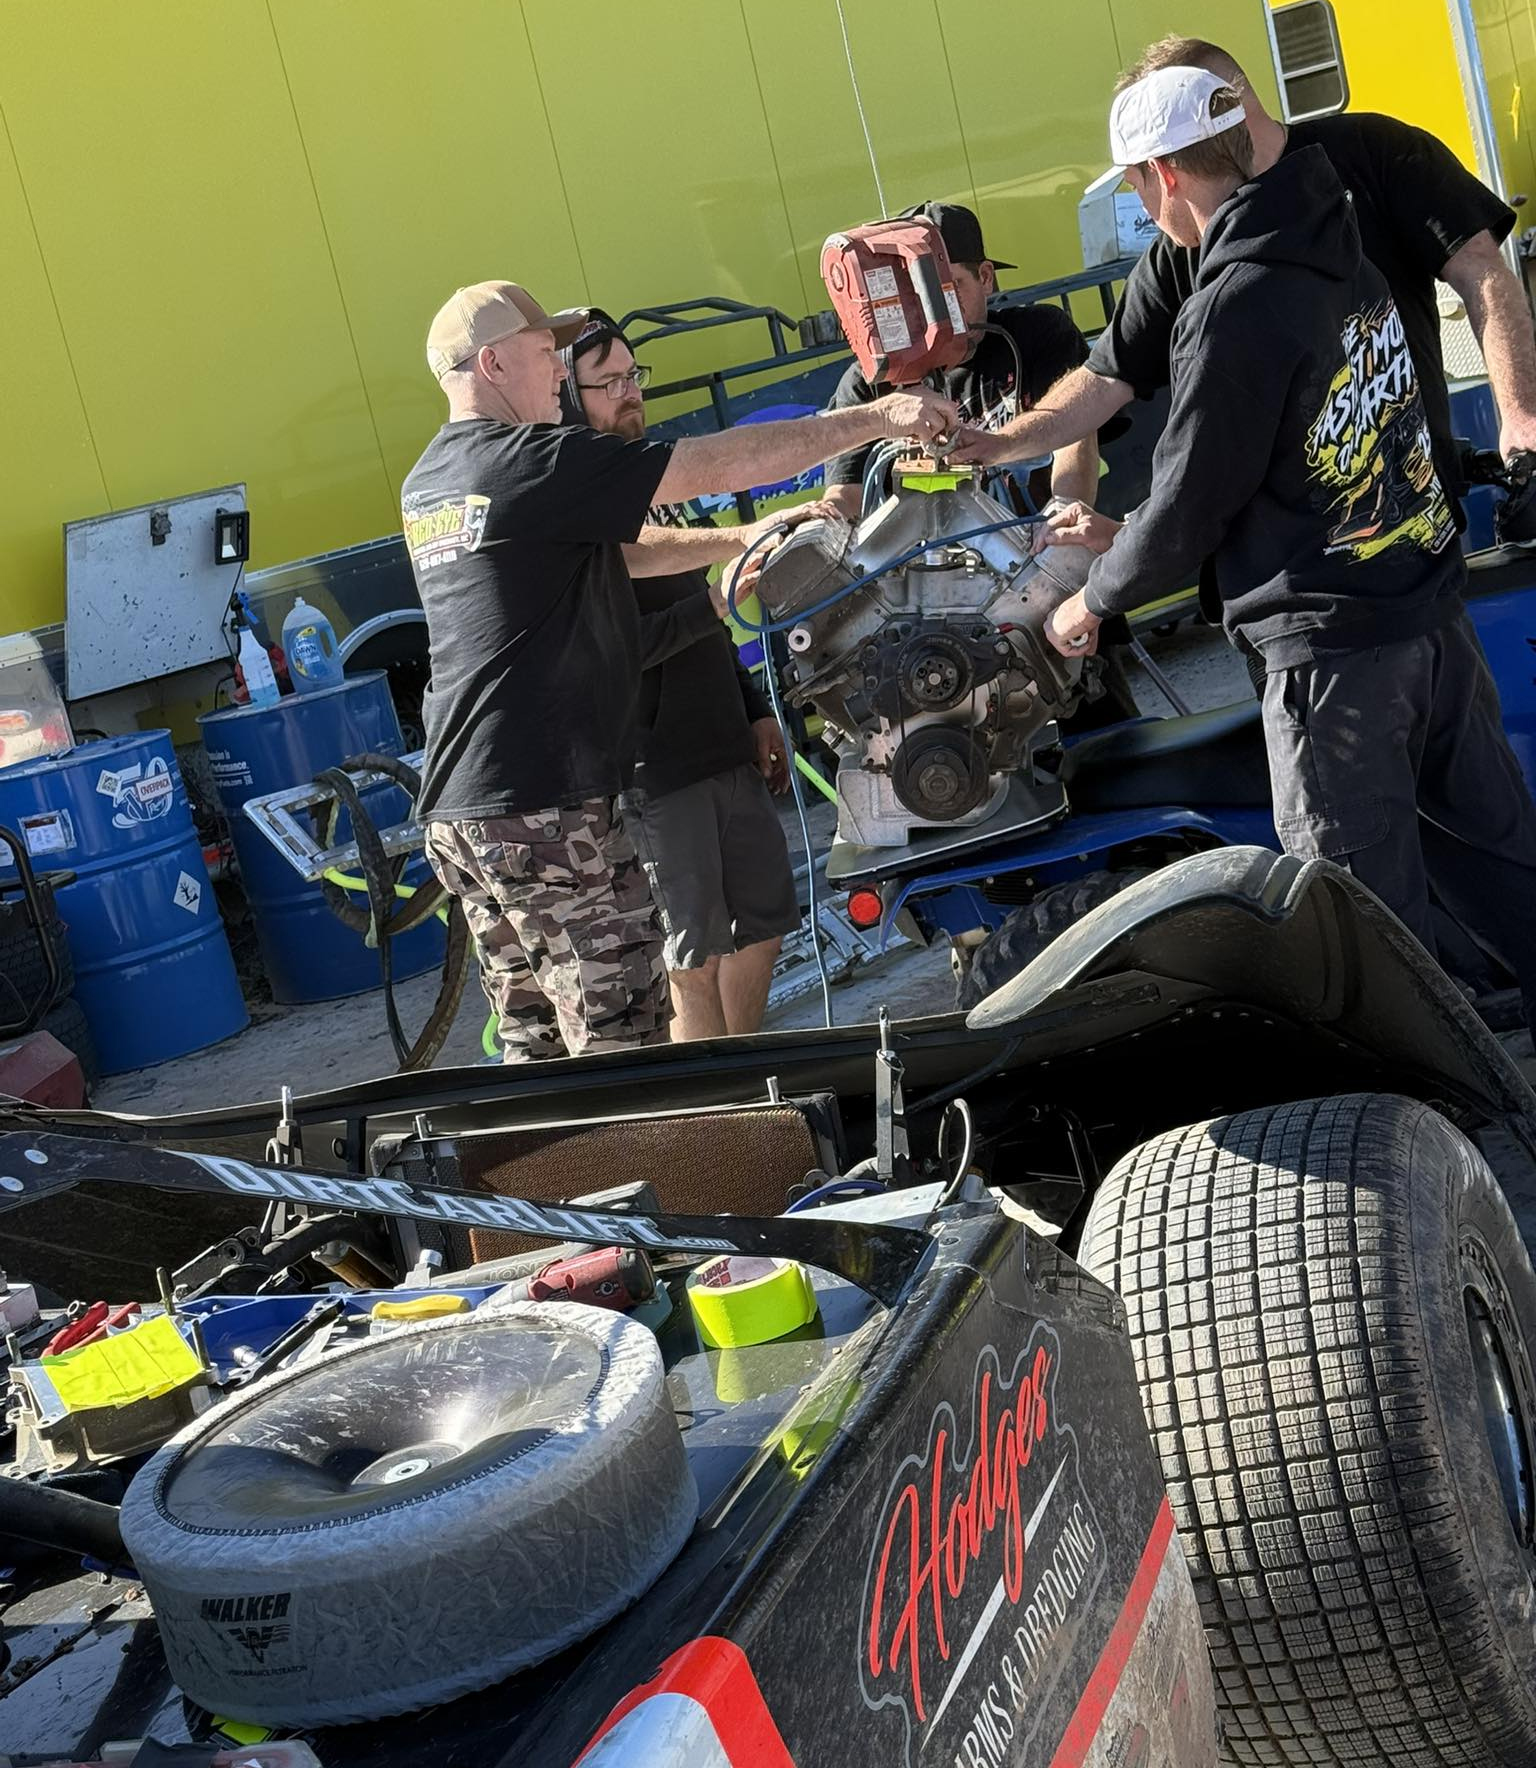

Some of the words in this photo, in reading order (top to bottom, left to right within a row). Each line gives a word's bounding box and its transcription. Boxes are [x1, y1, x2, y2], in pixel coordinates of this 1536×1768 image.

[140, 778, 171, 796] OVERPACK
[869, 1345, 1053, 1722] Hodges
[200, 1592, 291, 1622] WALKER
[1000, 1650, 1029, 1714] &
[1018, 1499, 1097, 1681] DREDGING
